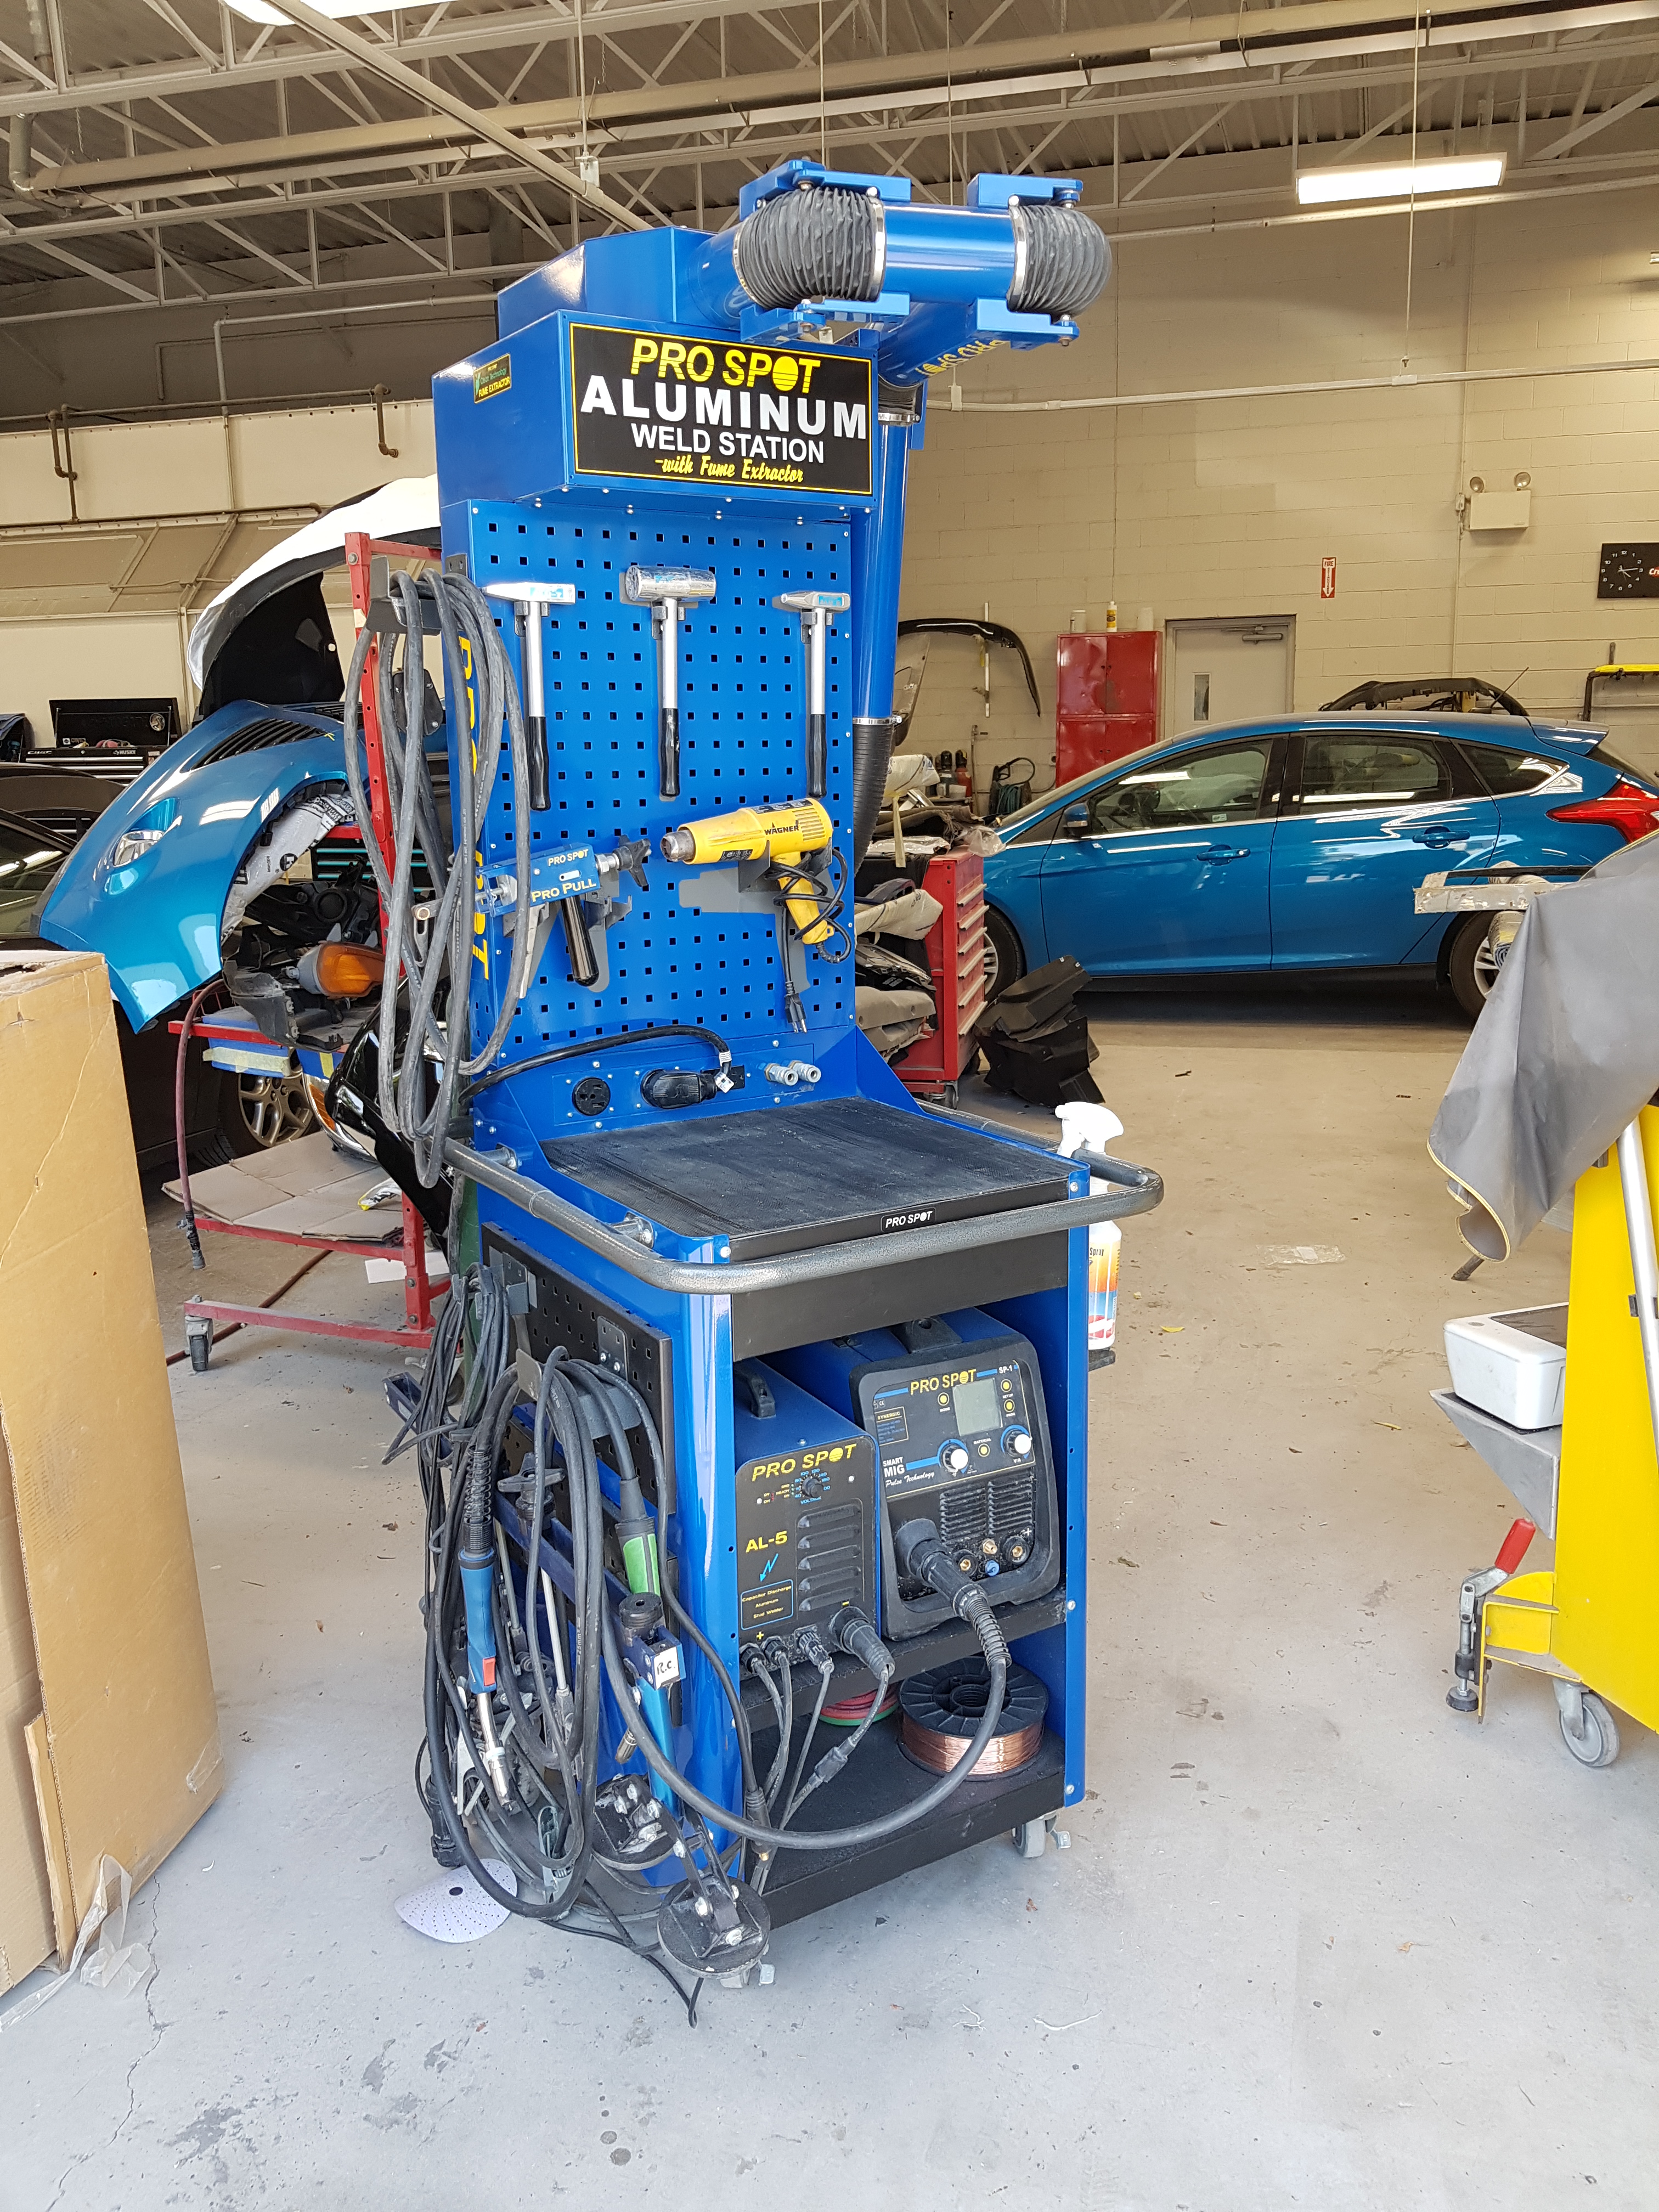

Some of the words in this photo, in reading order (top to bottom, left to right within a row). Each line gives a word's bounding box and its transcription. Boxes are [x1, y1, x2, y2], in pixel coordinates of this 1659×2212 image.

[631, 338, 714, 382] PRO
[723, 349, 821, 393] SPOT
[478, 386, 489, 398] FUME
[489, 376, 510, 393] EXTRACTOR
[580, 375, 866, 439] ALUMINUM
[631, 423, 711, 453] WELD
[719, 431, 824, 464] STATION
[699, 455, 735, 477] Fume
[741, 459, 804, 483] Extractor
[764, 824, 799, 836] WAGNER
[548, 855, 566, 867] PRO
[567, 849, 589, 861] SPOT
[531, 888, 560, 902] PRO
[562, 879, 597, 894] PULL
[885, 1216, 906, 1228] PRO
[907, 1210, 933, 1224] SPOT
[1090, 1247, 1104, 1256] Spray
[998, 1364, 1013, 1374] SP-1
[910, 1378, 939, 1395] PRO
[942, 1368, 977, 1389] SPOT
[877, 1412, 900, 1420] SYNERGIC
[752, 1458, 797, 1482] PRO
[802, 1443, 857, 1469] SPOT
[883, 1457, 904, 1467] SMART
[884, 1464, 905, 1478] MIG
[885, 1479, 902, 1488] Pulse
[904, 1471, 935, 1483] Technology
[746, 1530, 788, 1554] AL-5
[742, 1592, 766, 1602] Capacitor
[767, 1585, 792, 1596] Discharge
[755, 1598, 779, 1609] Aluminum
[766, 1606, 784, 1615] Welder
[657, 1660, 675, 1675] R.C.
